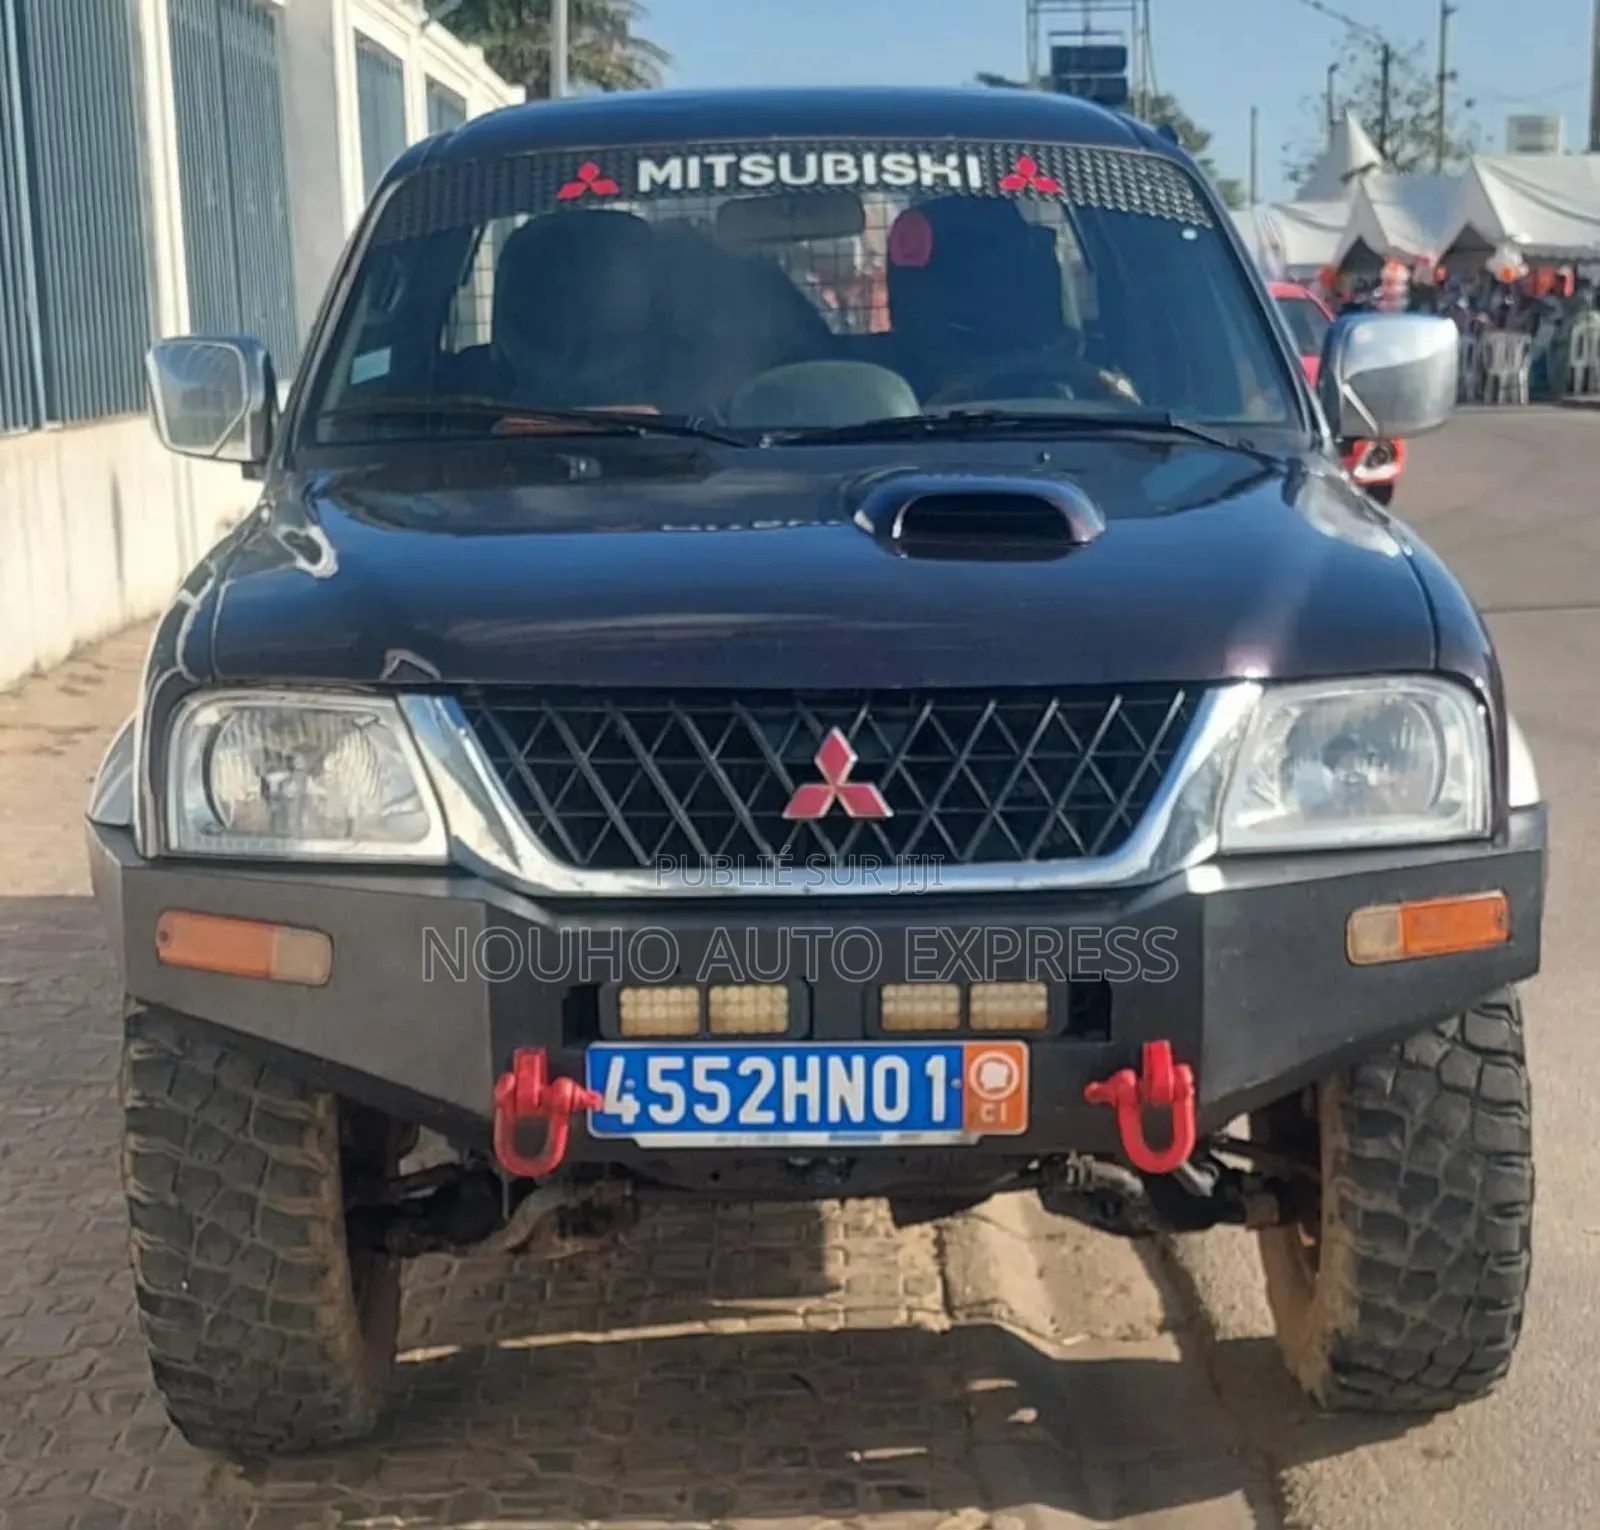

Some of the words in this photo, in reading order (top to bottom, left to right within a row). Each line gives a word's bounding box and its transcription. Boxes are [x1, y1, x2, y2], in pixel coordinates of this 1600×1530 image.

[637, 153, 983, 192] MITSUBISHI
[603, 1055, 947, 1124] 4552HN01
[980, 1102, 1008, 1123] CI
